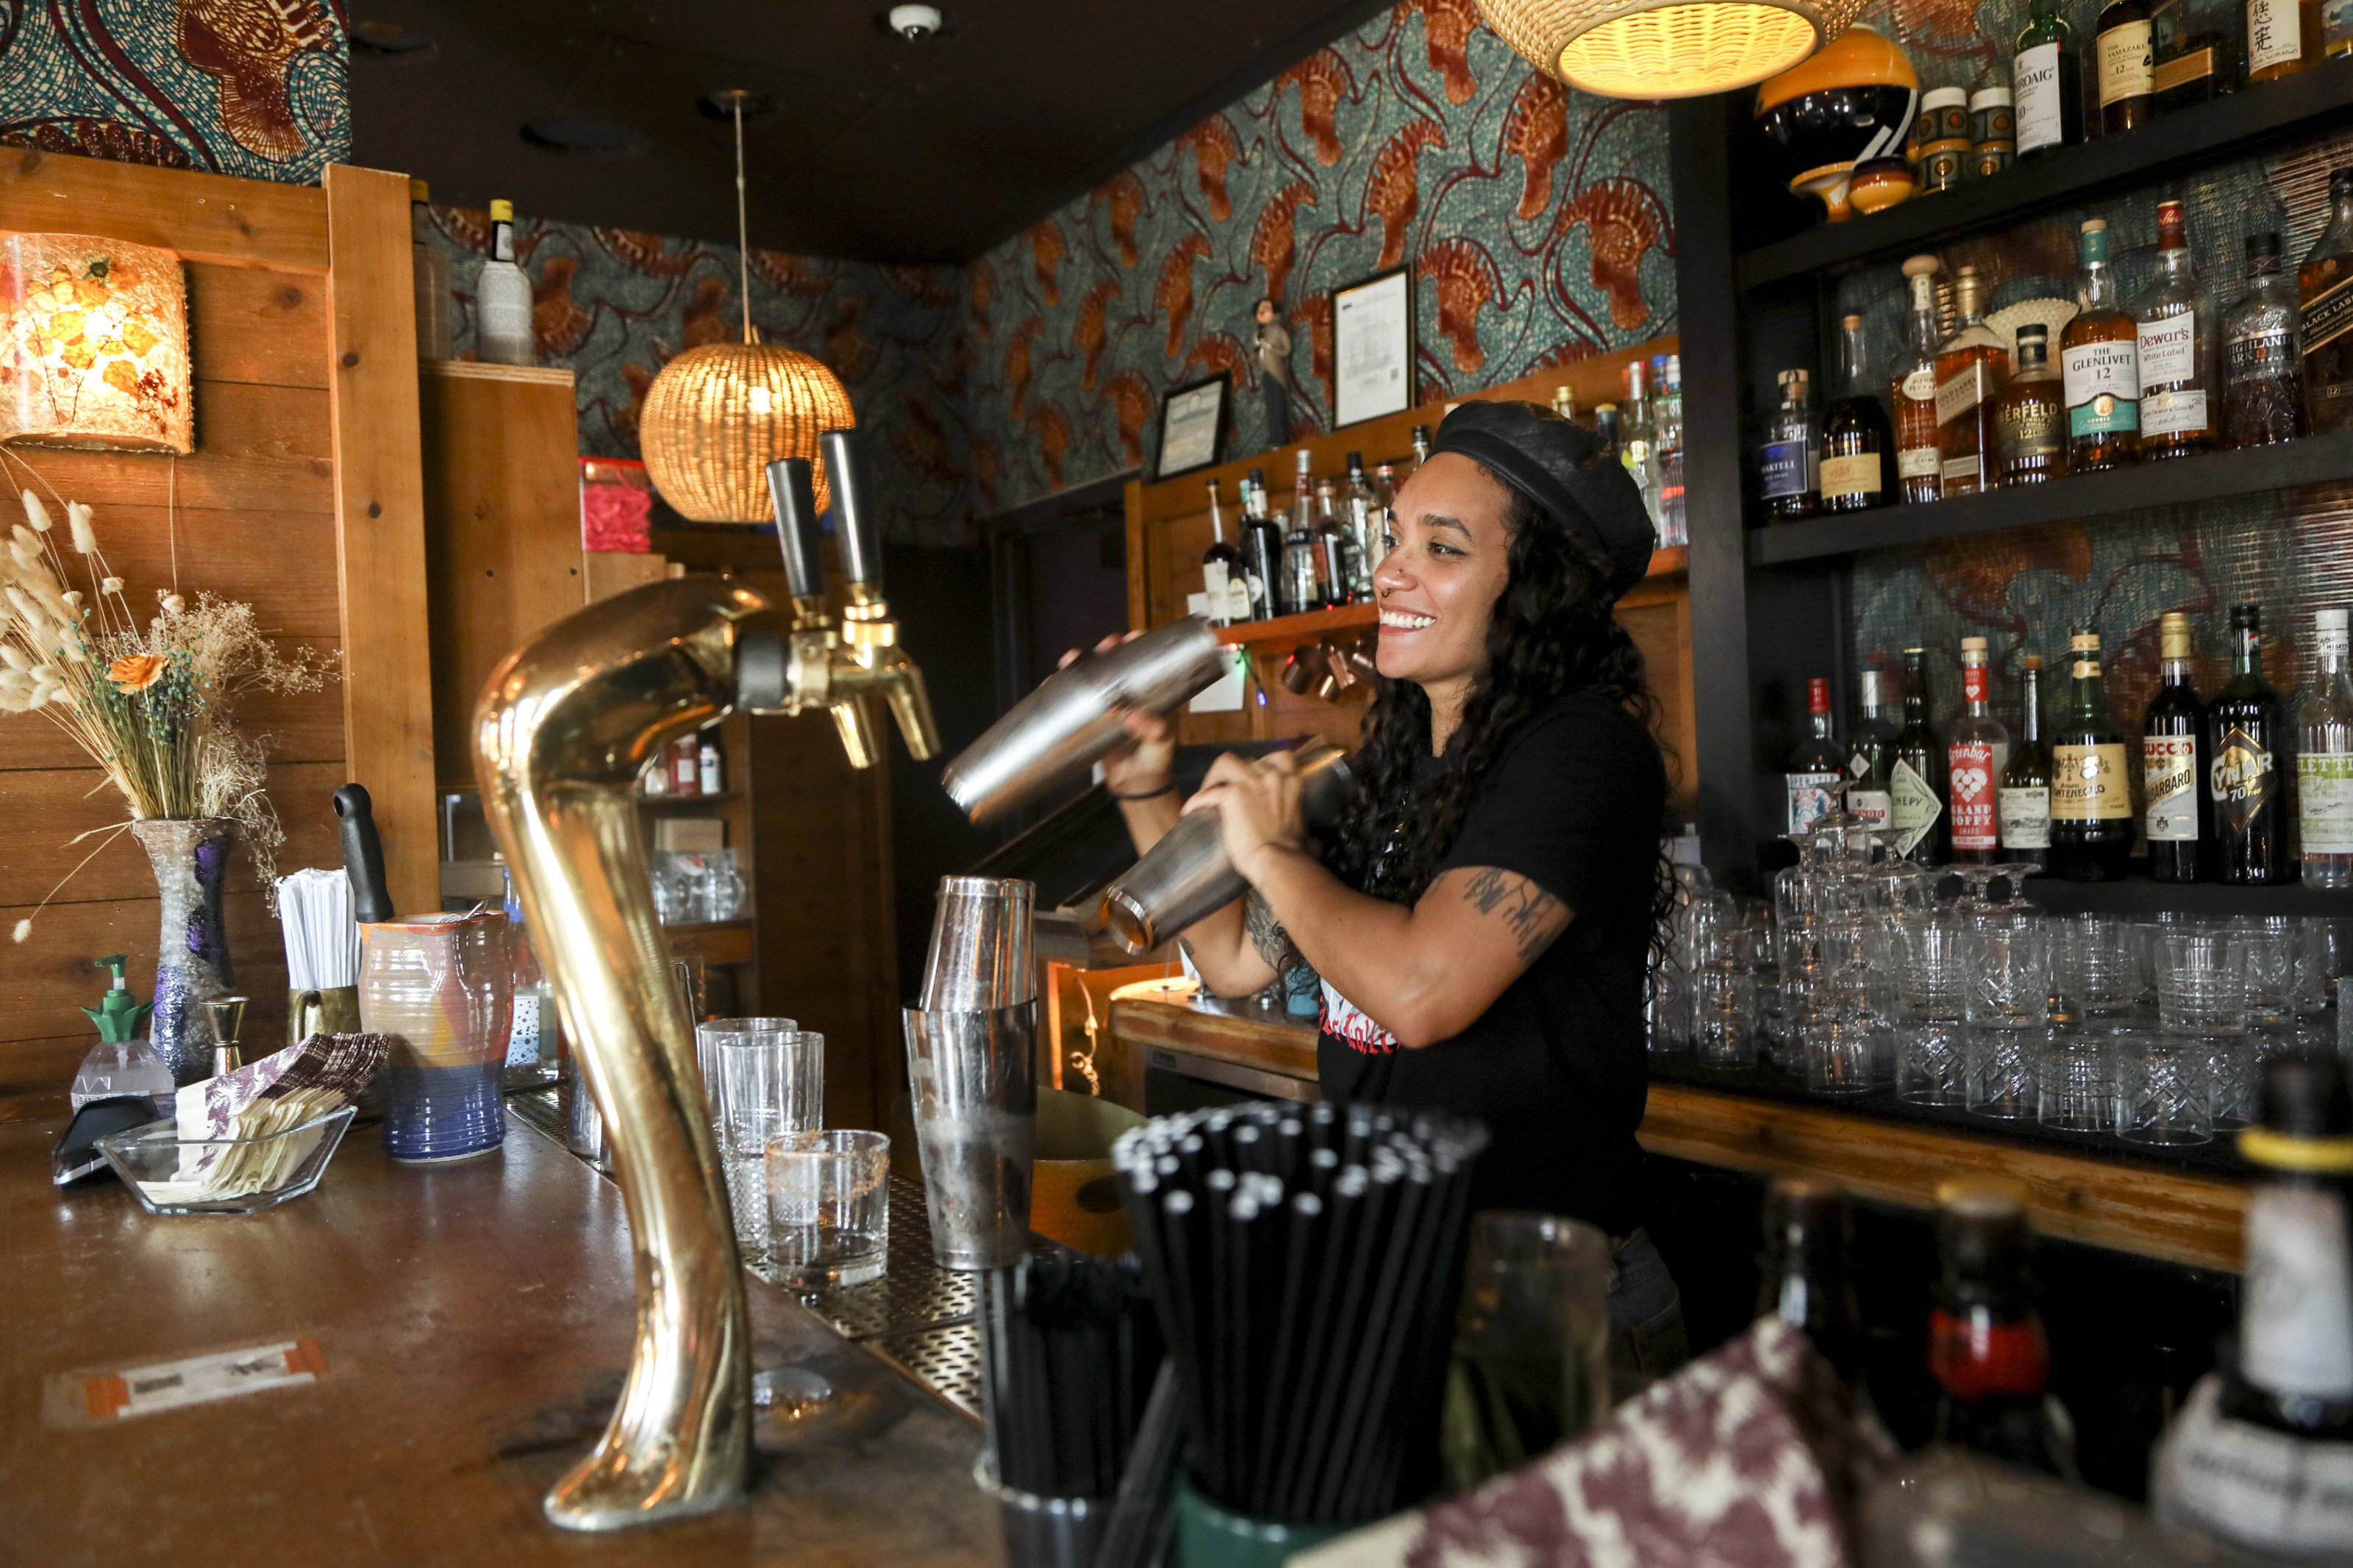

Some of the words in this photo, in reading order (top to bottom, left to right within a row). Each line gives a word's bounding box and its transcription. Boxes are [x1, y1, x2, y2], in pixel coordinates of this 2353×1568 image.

[2107, 43, 2146, 59] YAMAZAKI
[2115, 64, 2125, 75] 12
[2301, 309, 2332, 332] BLACK
[2093, 347, 2111, 356] THE
[2230, 350, 2253, 365] ARK
[2255, 348, 2268, 359] 12
[2072, 354, 2132, 371] GLENLIVET
[2096, 368, 2111, 379] 12
[2328, 387, 2338, 395] 12
[1999, 403, 2058, 423] BERFELD
[2018, 428, 2033, 440] 12
[2210, 751, 2274, 802] CYNAR
[2229, 786, 2248, 803] 70
[1951, 804, 1992, 815] GRAND
[1952, 815, 1991, 826] POPPY
